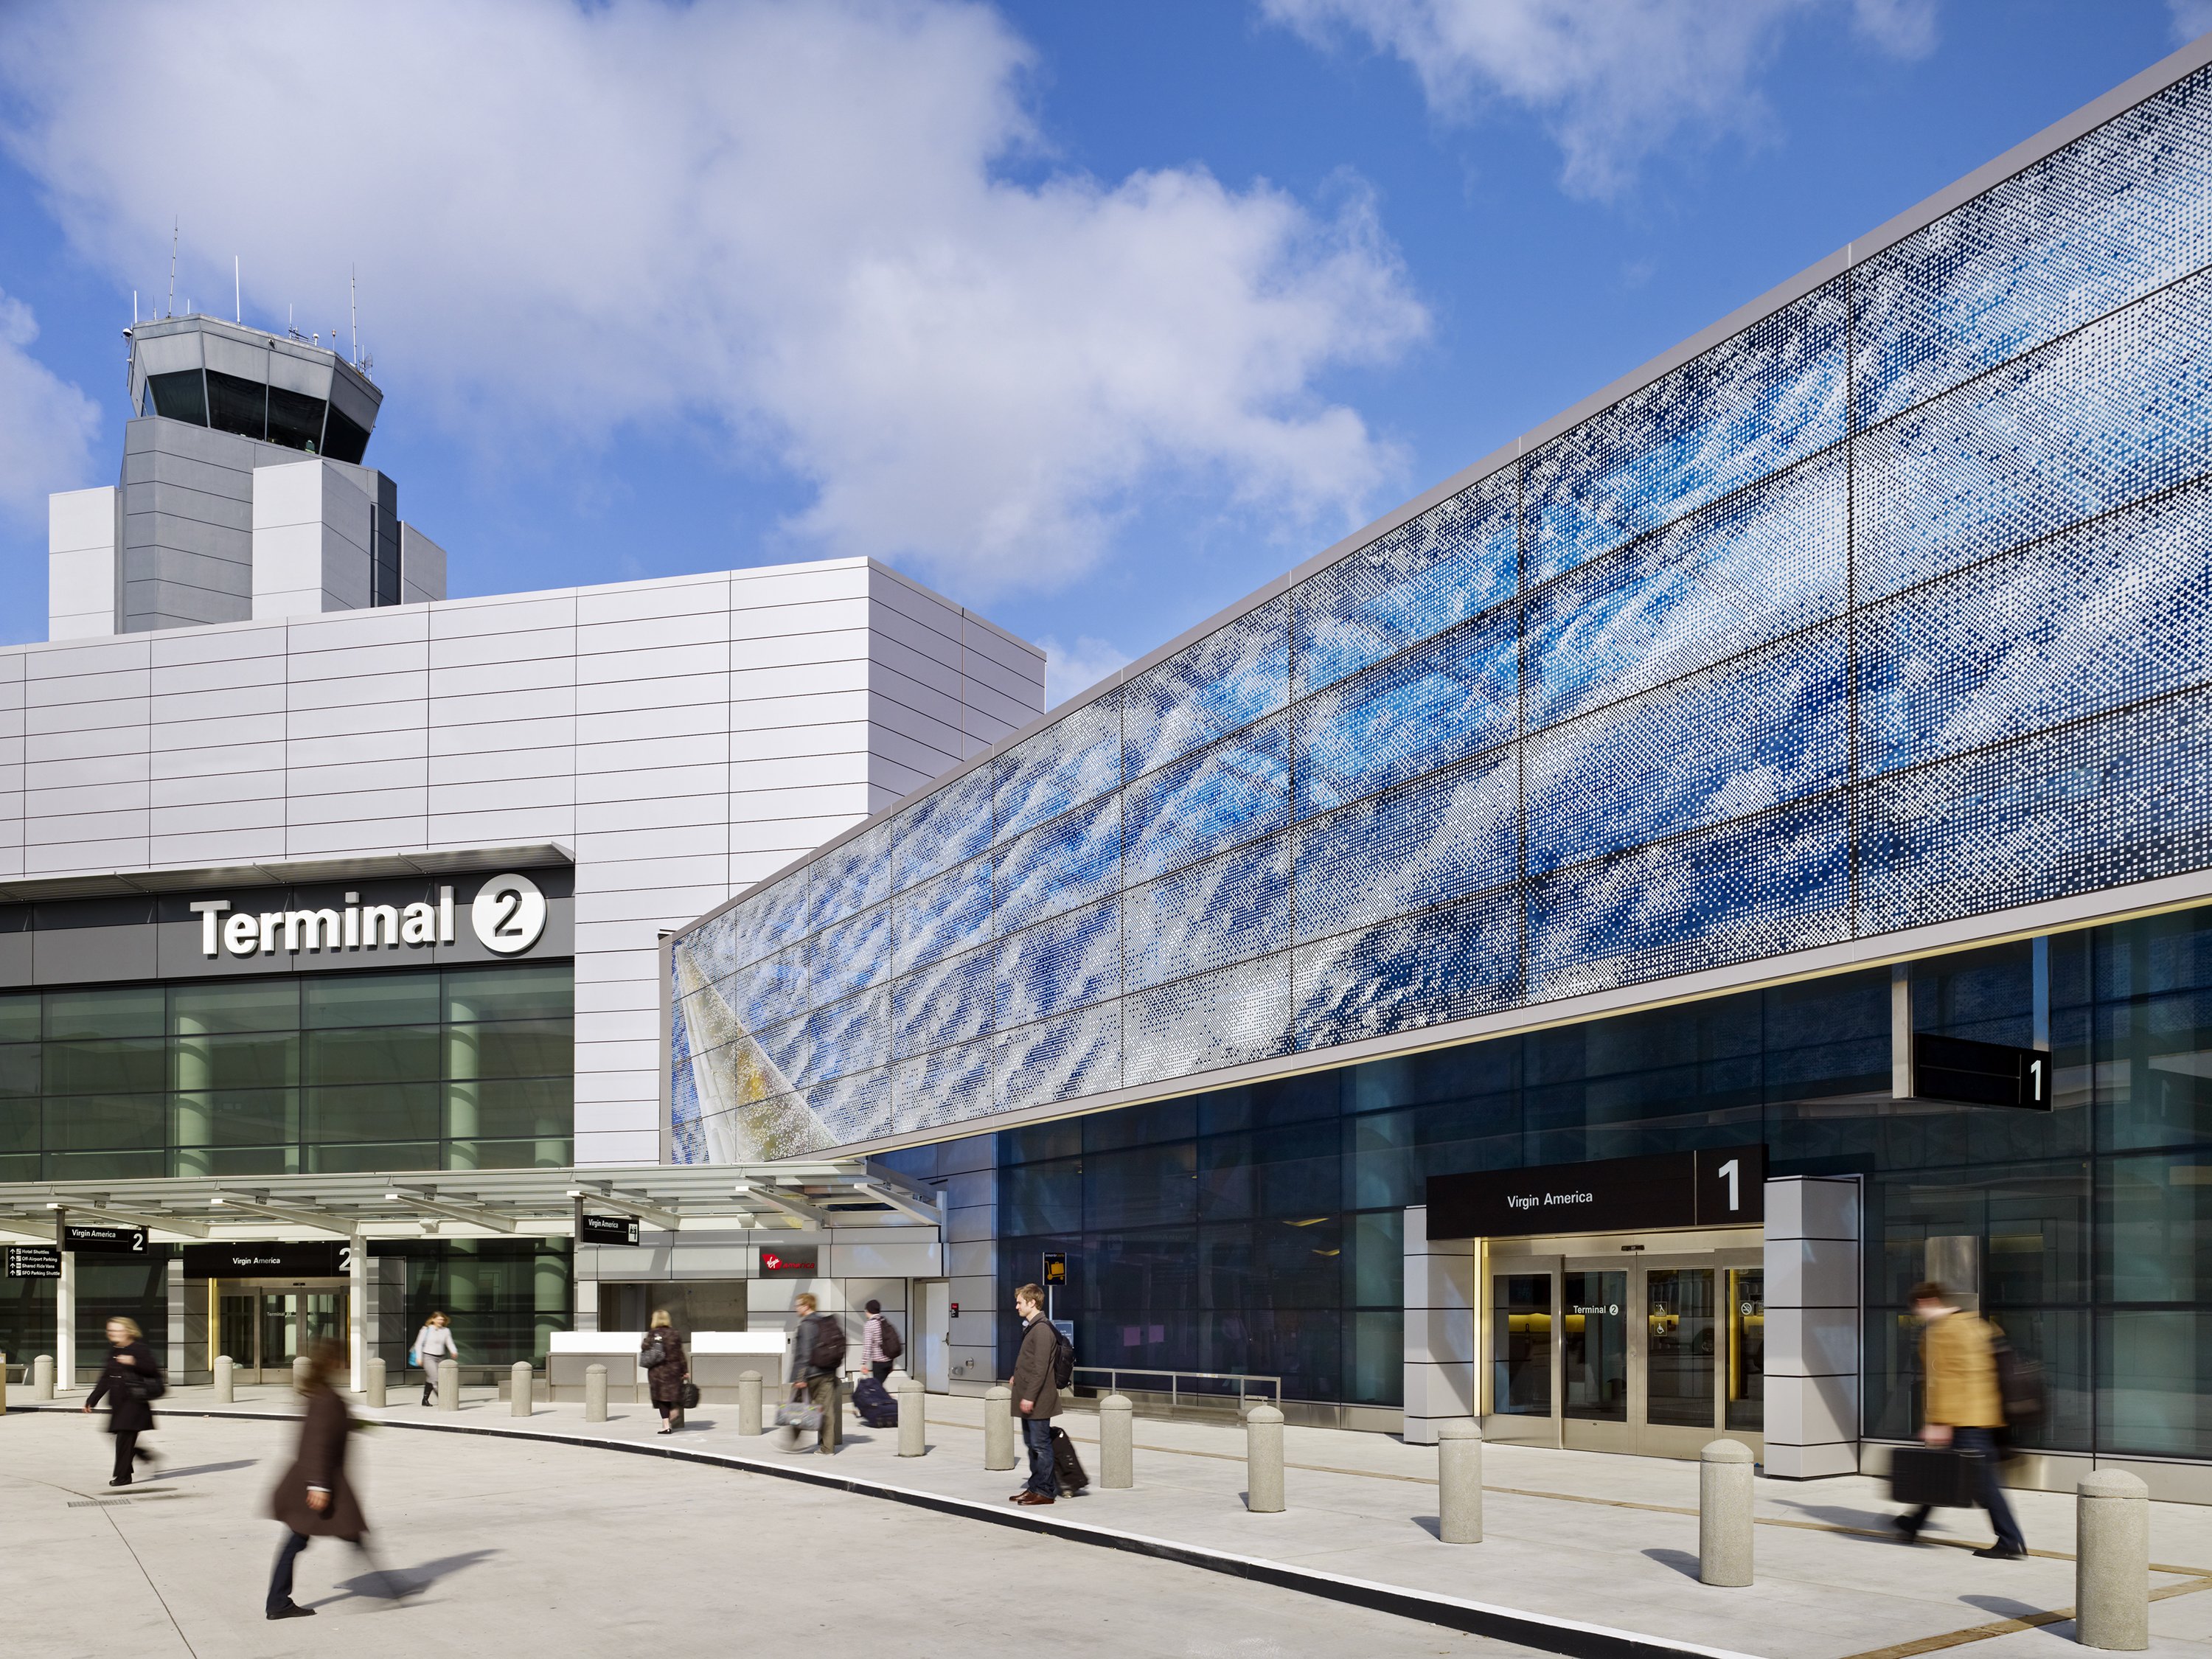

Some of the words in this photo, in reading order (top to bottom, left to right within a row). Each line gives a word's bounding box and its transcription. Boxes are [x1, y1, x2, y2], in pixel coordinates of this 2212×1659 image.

[189, 886, 454, 955] Terminal
[2031, 1060, 2041, 1101] 1
[1507, 1194, 1540, 1210] Virgin
[1543, 1190, 1593, 1206] America
[1718, 1159, 1739, 1211] 1
[588, 1219, 602, 1228] Virgin
[602, 1220, 619, 1228] America
[72, 1229, 91, 1238] Virgin
[91, 1230, 116, 1238] America
[133, 1233, 143, 1251] 2
[232, 1257, 251, 1265] Virgin
[338, 1247, 351, 1271] 2
[1573, 1305, 1606, 1314] Terminal
